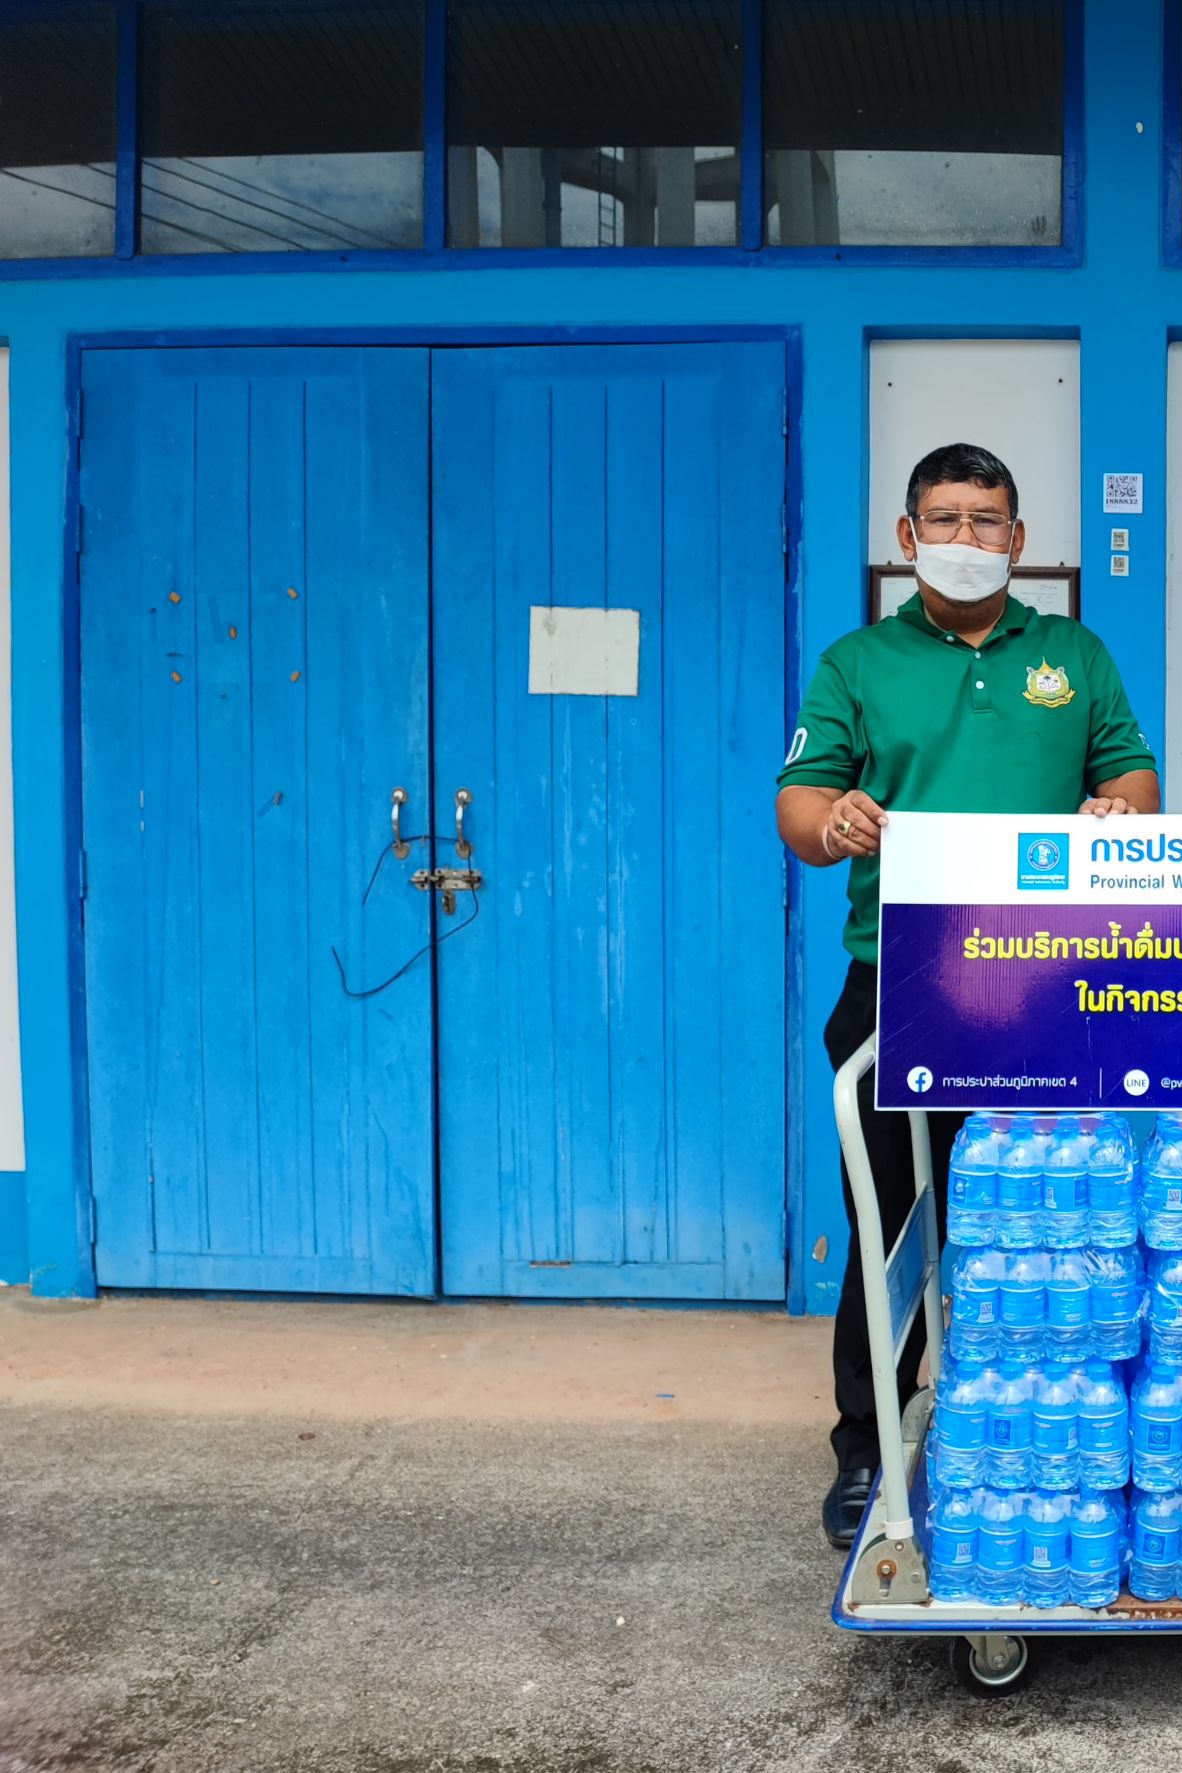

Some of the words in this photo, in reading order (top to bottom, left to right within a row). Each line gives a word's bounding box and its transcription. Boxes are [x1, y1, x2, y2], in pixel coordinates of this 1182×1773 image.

[1090, 874, 1165, 889] Provincial
[1069, 1076, 1078, 1087] 4
[1126, 1079, 1147, 1088] LINE
